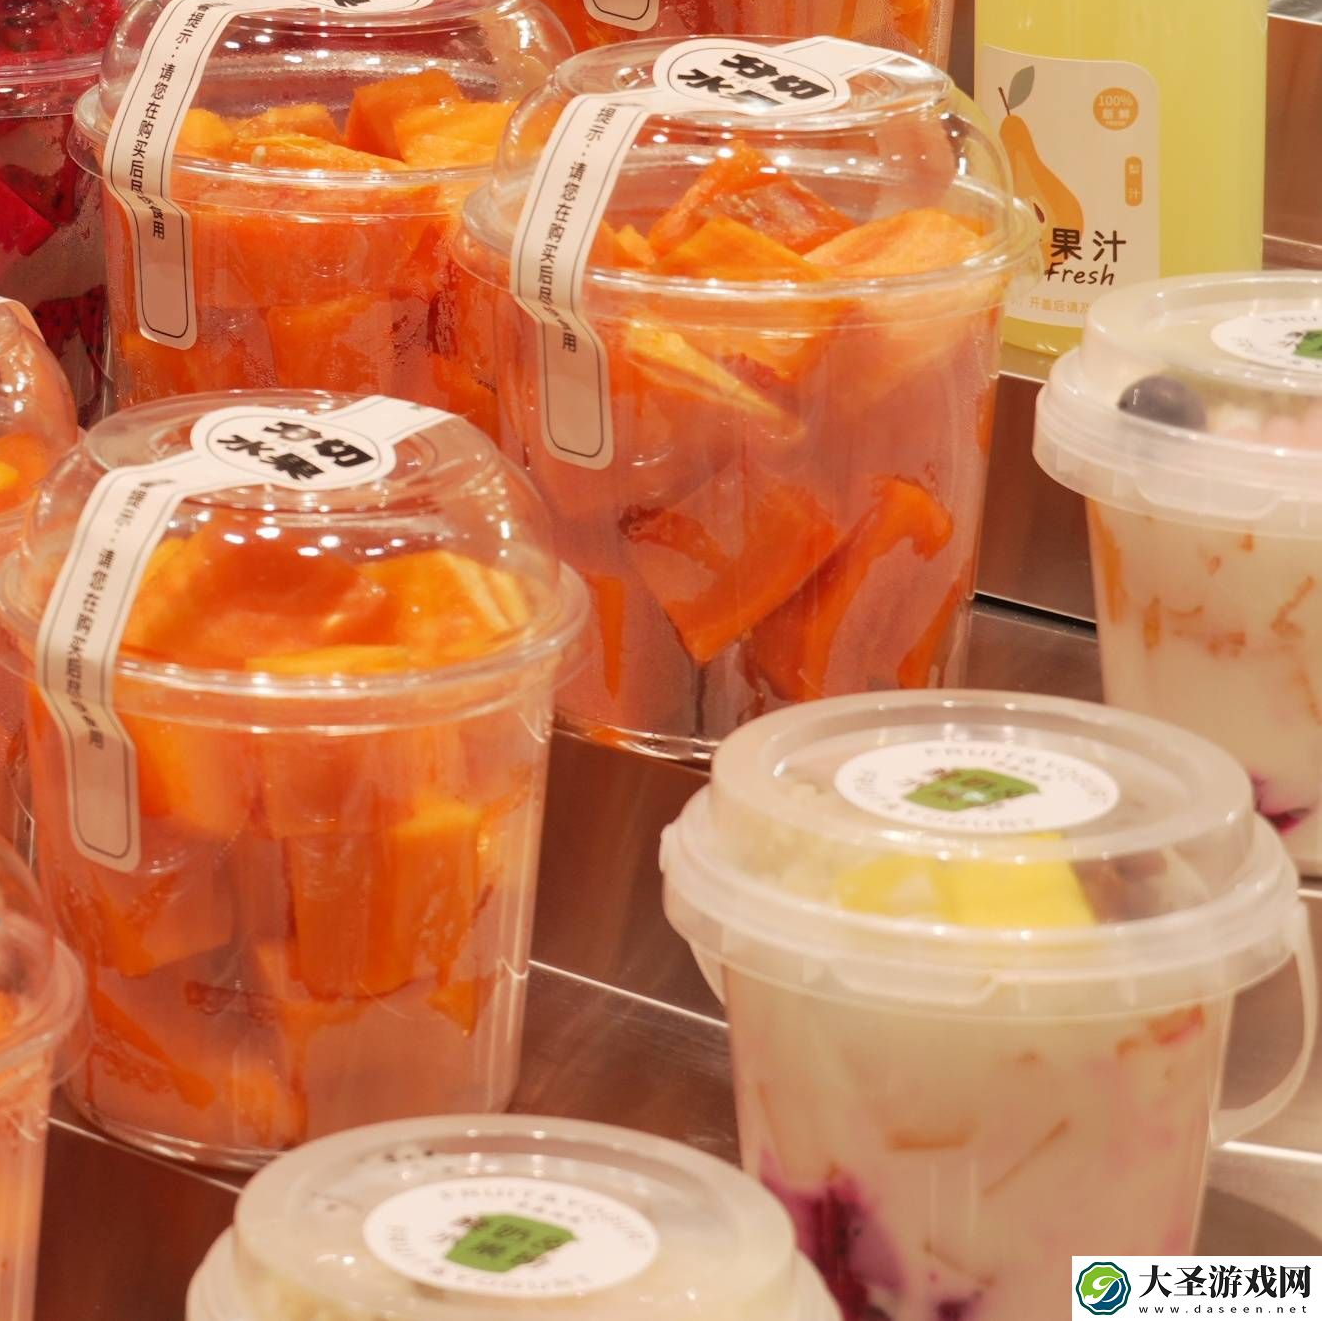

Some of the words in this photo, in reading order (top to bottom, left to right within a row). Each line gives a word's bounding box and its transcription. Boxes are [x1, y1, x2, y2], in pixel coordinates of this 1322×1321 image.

[719, 54, 830, 99] 分切
[1044, 262, 1115, 287] Fresh
[217, 435, 325, 480] 水果
